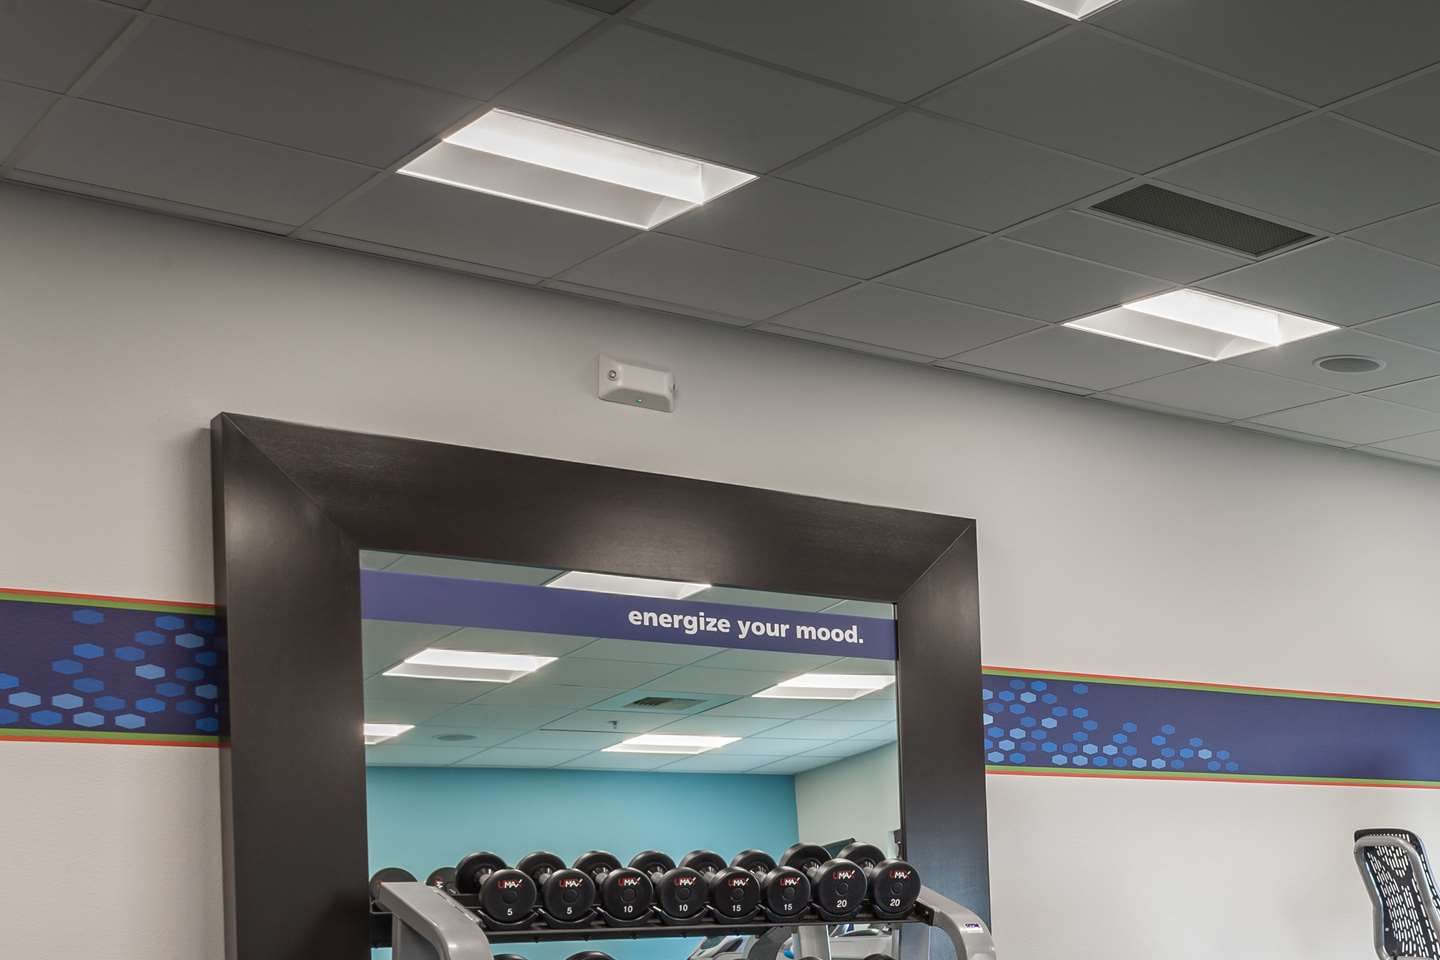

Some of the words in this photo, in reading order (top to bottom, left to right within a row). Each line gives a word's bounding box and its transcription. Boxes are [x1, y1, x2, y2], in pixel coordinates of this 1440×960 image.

[628, 610, 731, 634] energize
[738, 619, 790, 639] your
[796, 624, 864, 644] mood.
[783, 903, 793, 911] 15
[836, 899, 848, 908] 20
[889, 898, 901, 907] 20
[507, 908, 513, 916] 5
[566, 906, 572, 915] 5
[623, 905, 633, 914] 10
[679, 904, 688, 912] 10
[732, 904, 742, 912] 15
